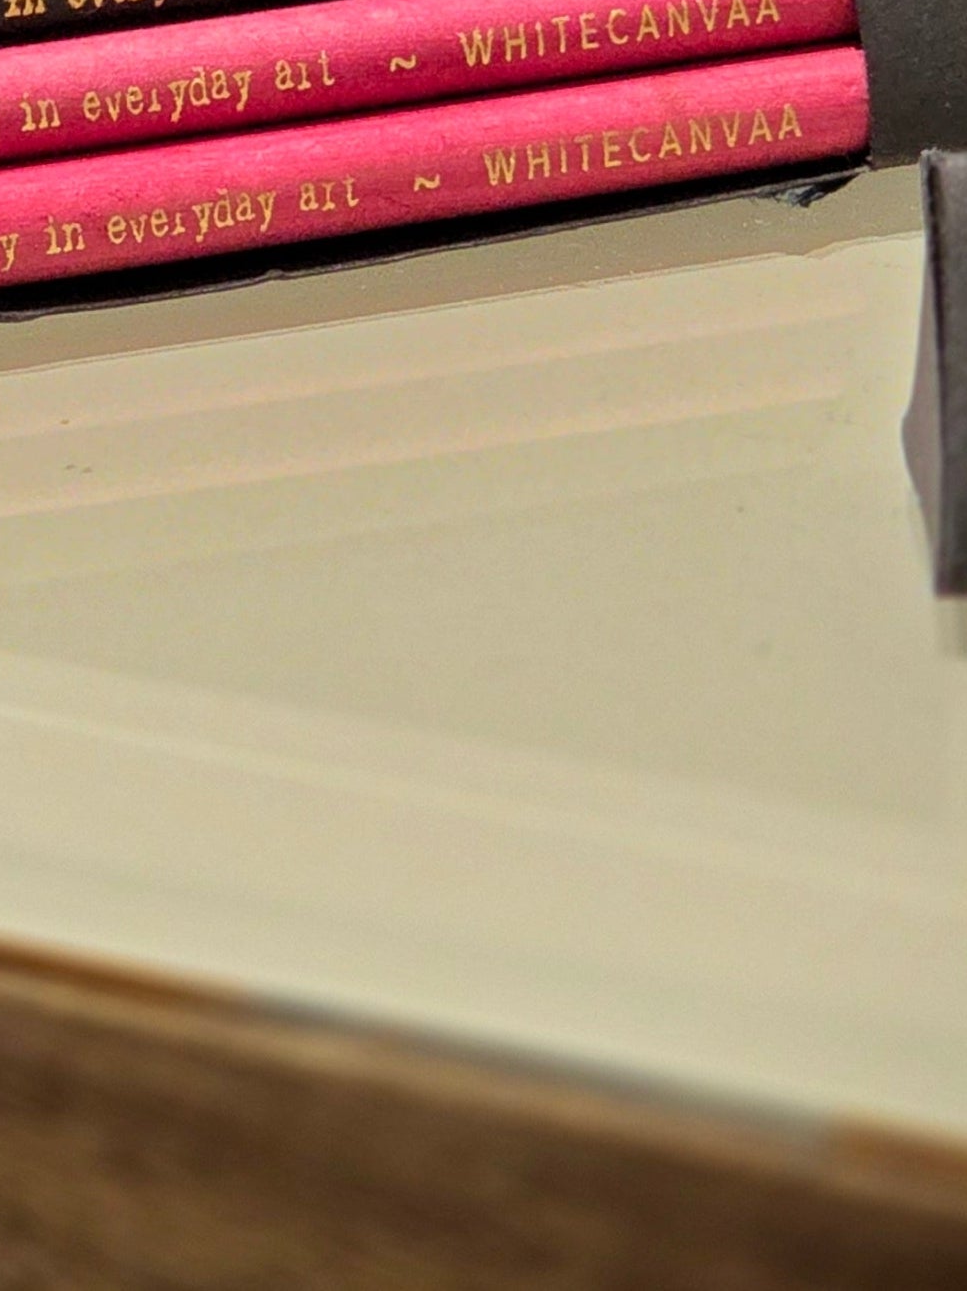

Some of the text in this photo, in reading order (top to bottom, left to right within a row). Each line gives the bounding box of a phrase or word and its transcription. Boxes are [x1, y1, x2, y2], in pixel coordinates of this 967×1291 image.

[20, 93, 61, 133] in
[44, 216, 85, 257] in
[482, 103, 804, 187] WHITECANVAA
